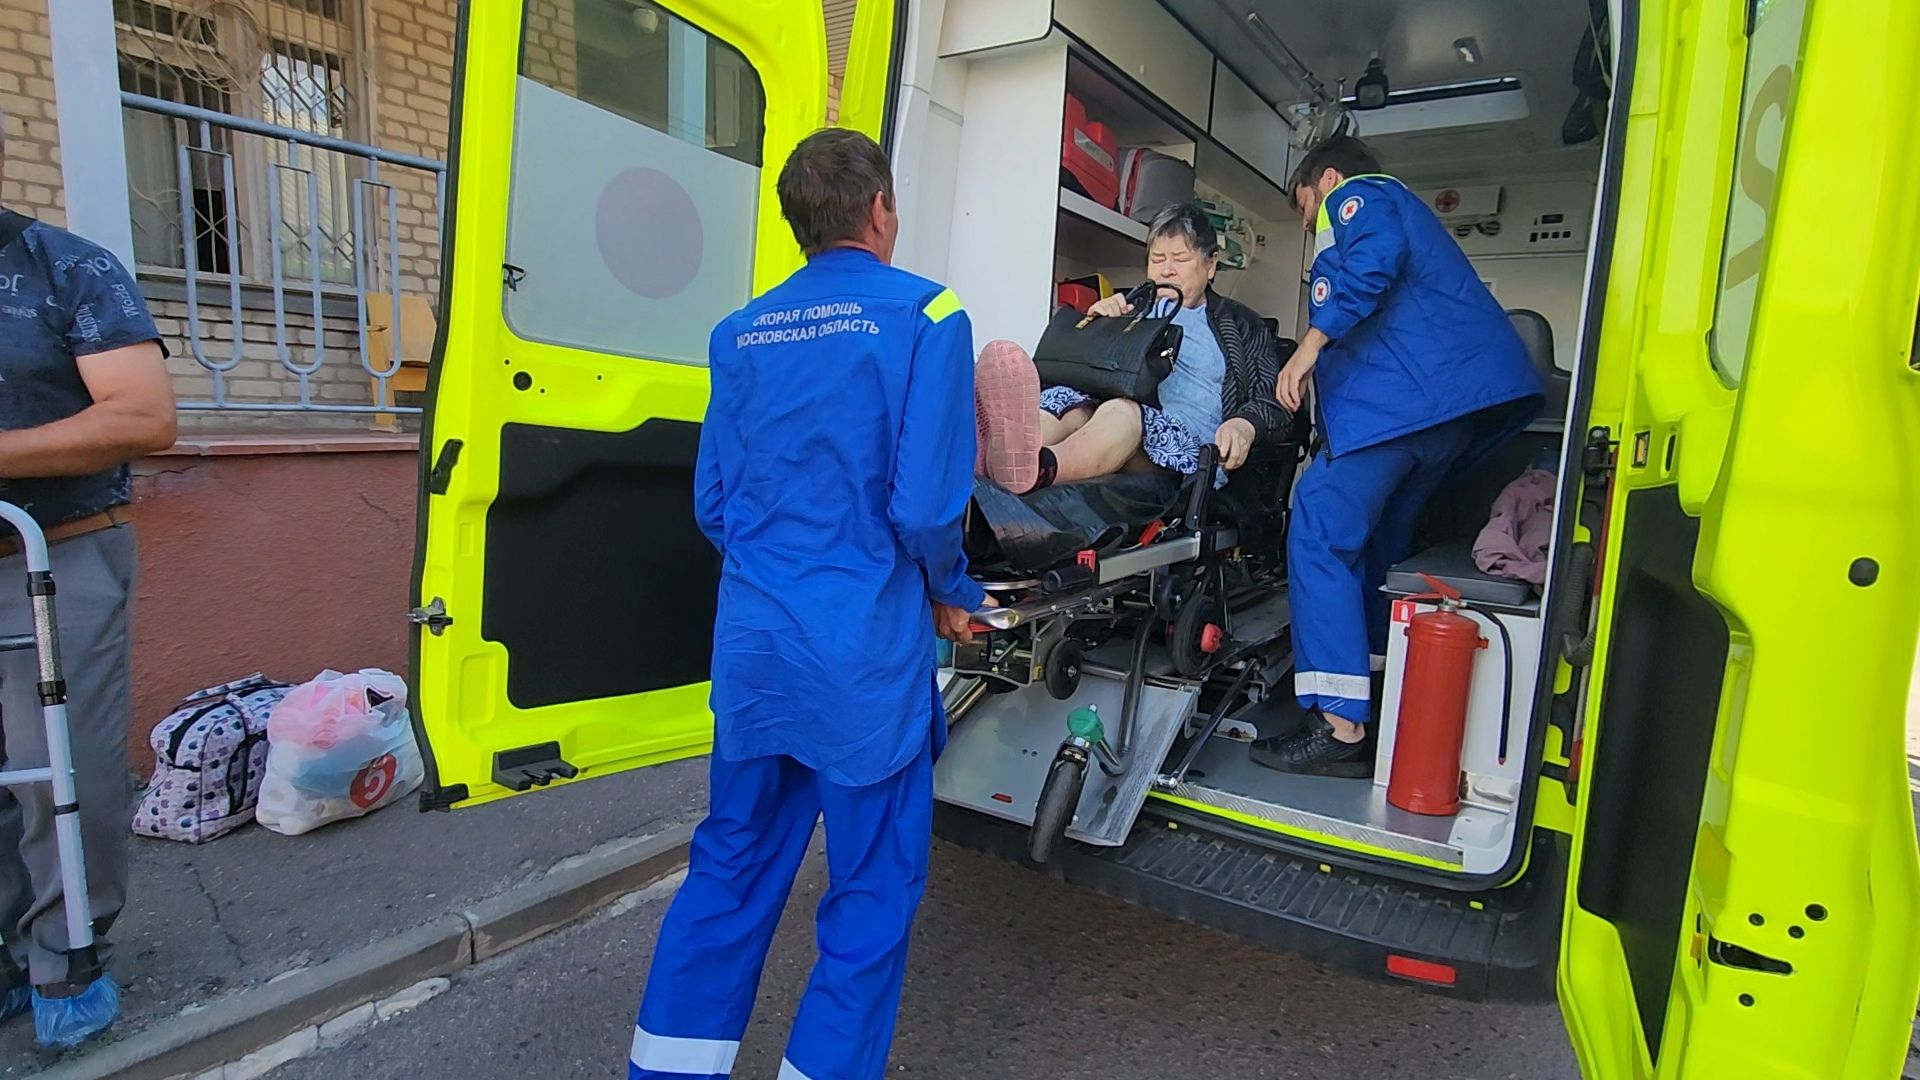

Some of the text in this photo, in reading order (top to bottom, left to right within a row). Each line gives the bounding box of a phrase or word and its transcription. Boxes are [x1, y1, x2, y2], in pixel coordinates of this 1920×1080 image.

[111, 283, 139, 318] World
[802, 302, 863, 320] ПОМОЩЬ
[736, 319, 880, 349] МОСКОВСКАЯ ОБЛАСТЬ
